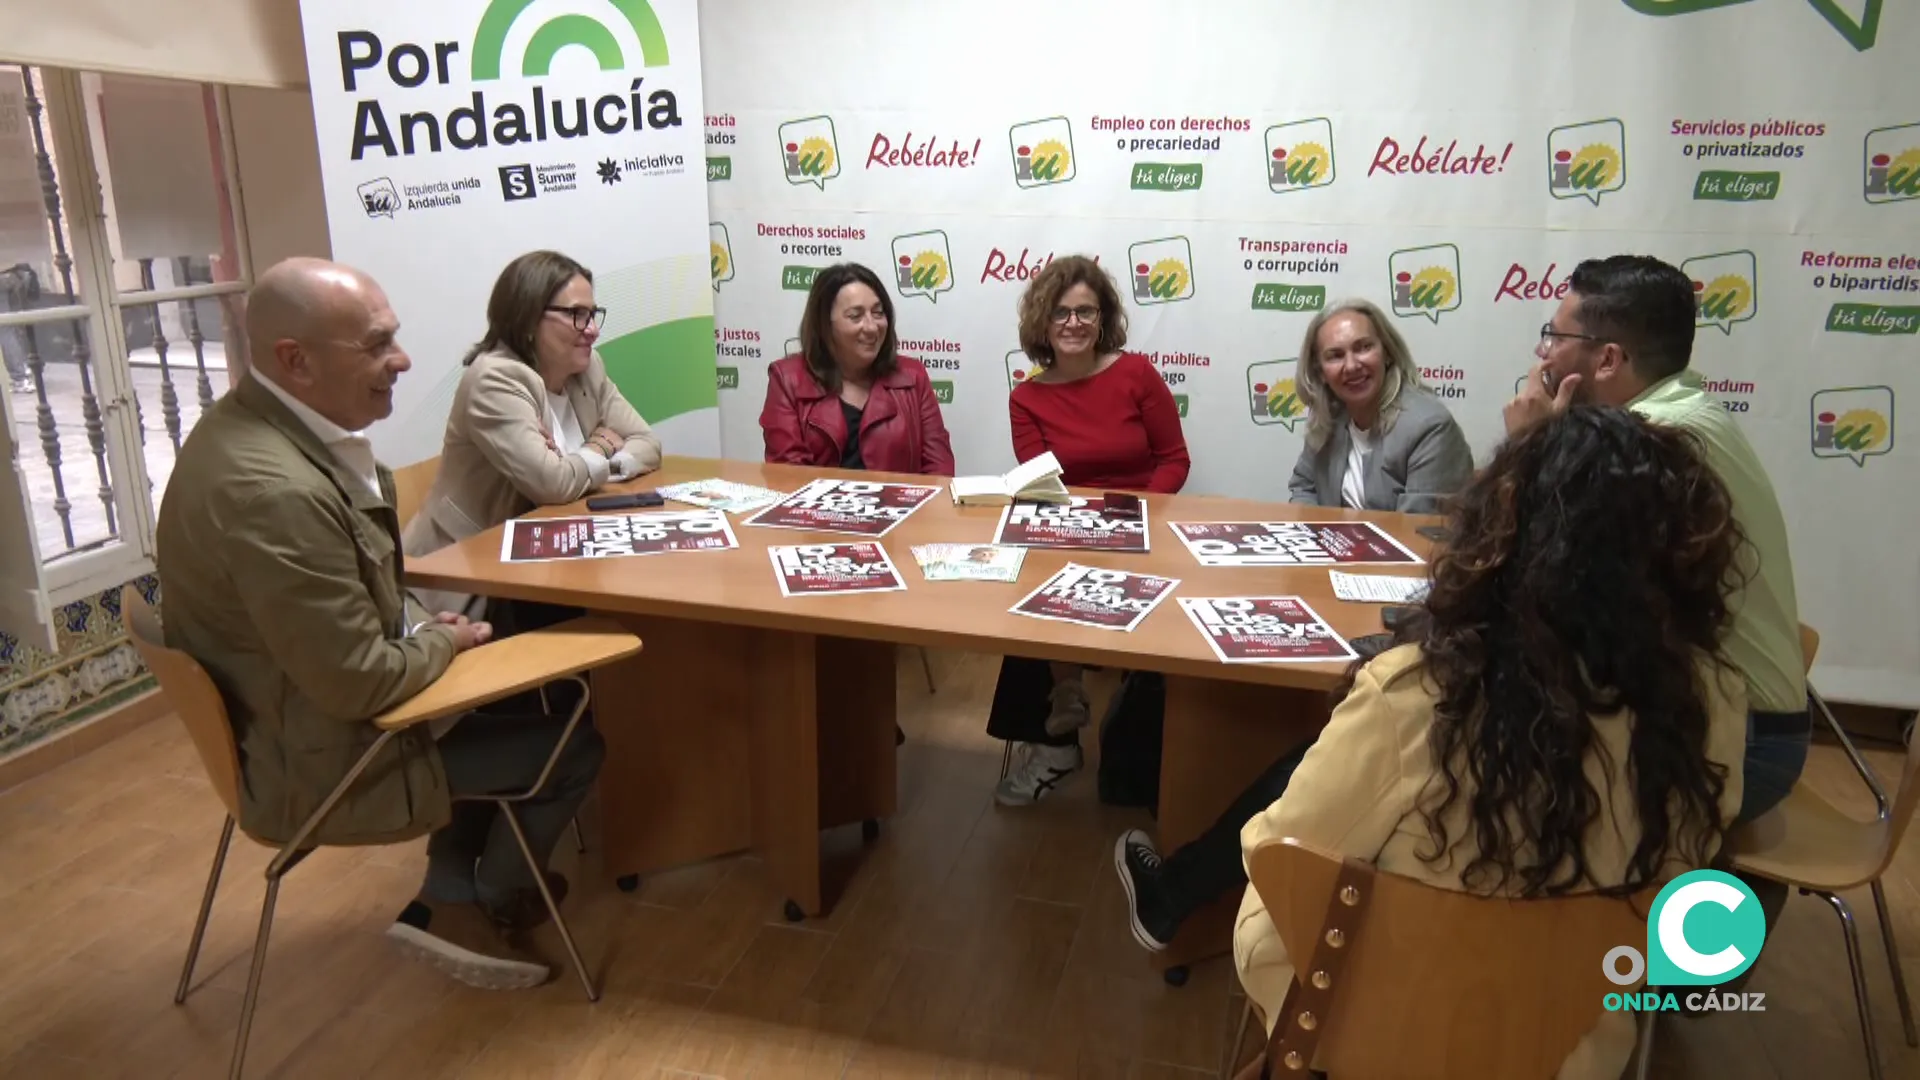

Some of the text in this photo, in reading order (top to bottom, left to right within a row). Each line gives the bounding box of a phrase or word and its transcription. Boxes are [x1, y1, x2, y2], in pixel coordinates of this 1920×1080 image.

[337, 29, 459, 92] Por
[350, 77, 682, 161] Andalucía
[1091, 115, 1251, 133] Empleo con derechos
[1671, 118, 1826, 138] Servicios públicos
[704, 131, 736, 145] ados
[1117, 137, 1221, 152] o precariedad
[865, 131, 982, 170] Rebélate!
[1367, 135, 1514, 178] Rebélate!
[1683, 141, 1805, 160] o privatizados
[624, 153, 684, 172] iniciativa
[451, 177, 481, 190] unida
[538, 172, 577, 184] Sumar
[1136, 165, 1198, 190] tú eliges
[1701, 174, 1774, 200] tú eliges
[757, 222, 866, 240] Derechos sociales
[781, 243, 842, 256] o recortes
[1238, 237, 1348, 255] Transparencia
[1244, 257, 1339, 275] o corrupción
[1800, 250, 1882, 270] Reforma
[1494, 263, 1572, 302] Rebé
[1813, 273, 1919, 292] o bipartidis
[1257, 287, 1321, 311] tú eliges
[1833, 307, 1915, 333] tú eliges
[723, 327, 761, 342] justos
[716, 343, 762, 358] fiscales
[896, 339, 961, 352] enovables
[920, 355, 960, 370] leares
[1162, 351, 1210, 368] pública
[1416, 364, 1464, 380] ación
[1434, 383, 1467, 399] ción
[1700, 375, 1755, 394] éndum
